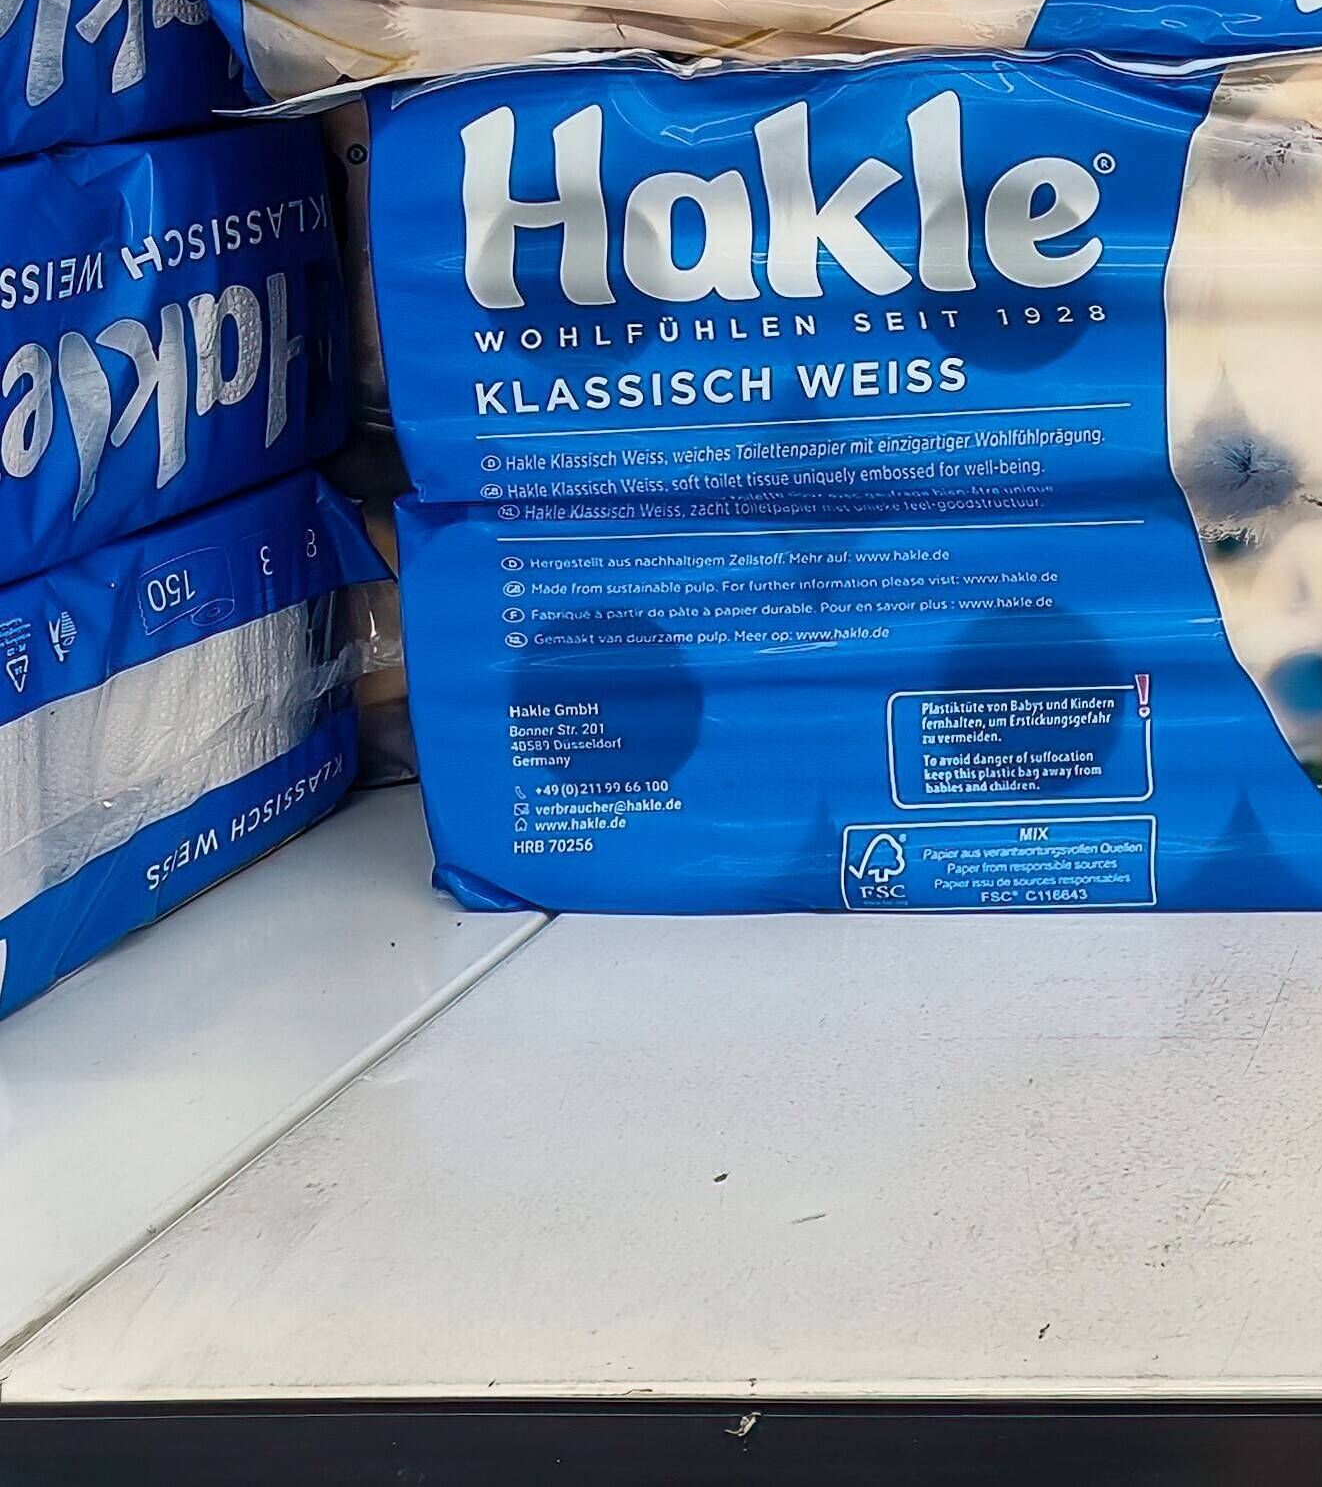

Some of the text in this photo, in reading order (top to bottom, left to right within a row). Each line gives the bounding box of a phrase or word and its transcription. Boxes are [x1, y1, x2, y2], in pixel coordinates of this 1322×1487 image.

[0, 194, 329, 309] KLASSISCH WEISS
[474, 305, 1106, 352] WOHLFÜHLEN SEIT 1928
[475, 358, 968, 416] KLASSISCH WEISS
[261, 546, 273, 574] 3
[148, 569, 196, 611] 150
[509, 703, 598, 718] Hakle GmbH
[922, 697, 1115, 715] Plastiktüte von Babys und Kindern
[922, 713, 1111, 730] fernhalten, um Erstickungsgefahr
[509, 723, 605, 737] Bonner Str. 201
[511, 738, 622, 752] 40589 Düsseldorf
[512, 755, 571, 768] Germany
[535, 798, 682, 815] verbraucher@hakle.de
[146, 752, 345, 890] KLASSISCH WEISS
[535, 818, 626, 831] www.hakle.de
[1019, 828, 1048, 841] MIX
[513, 838, 594, 853] HRB 70256
[862, 885, 905, 899] FSC
[1026, 889, 1087, 902] C116643
